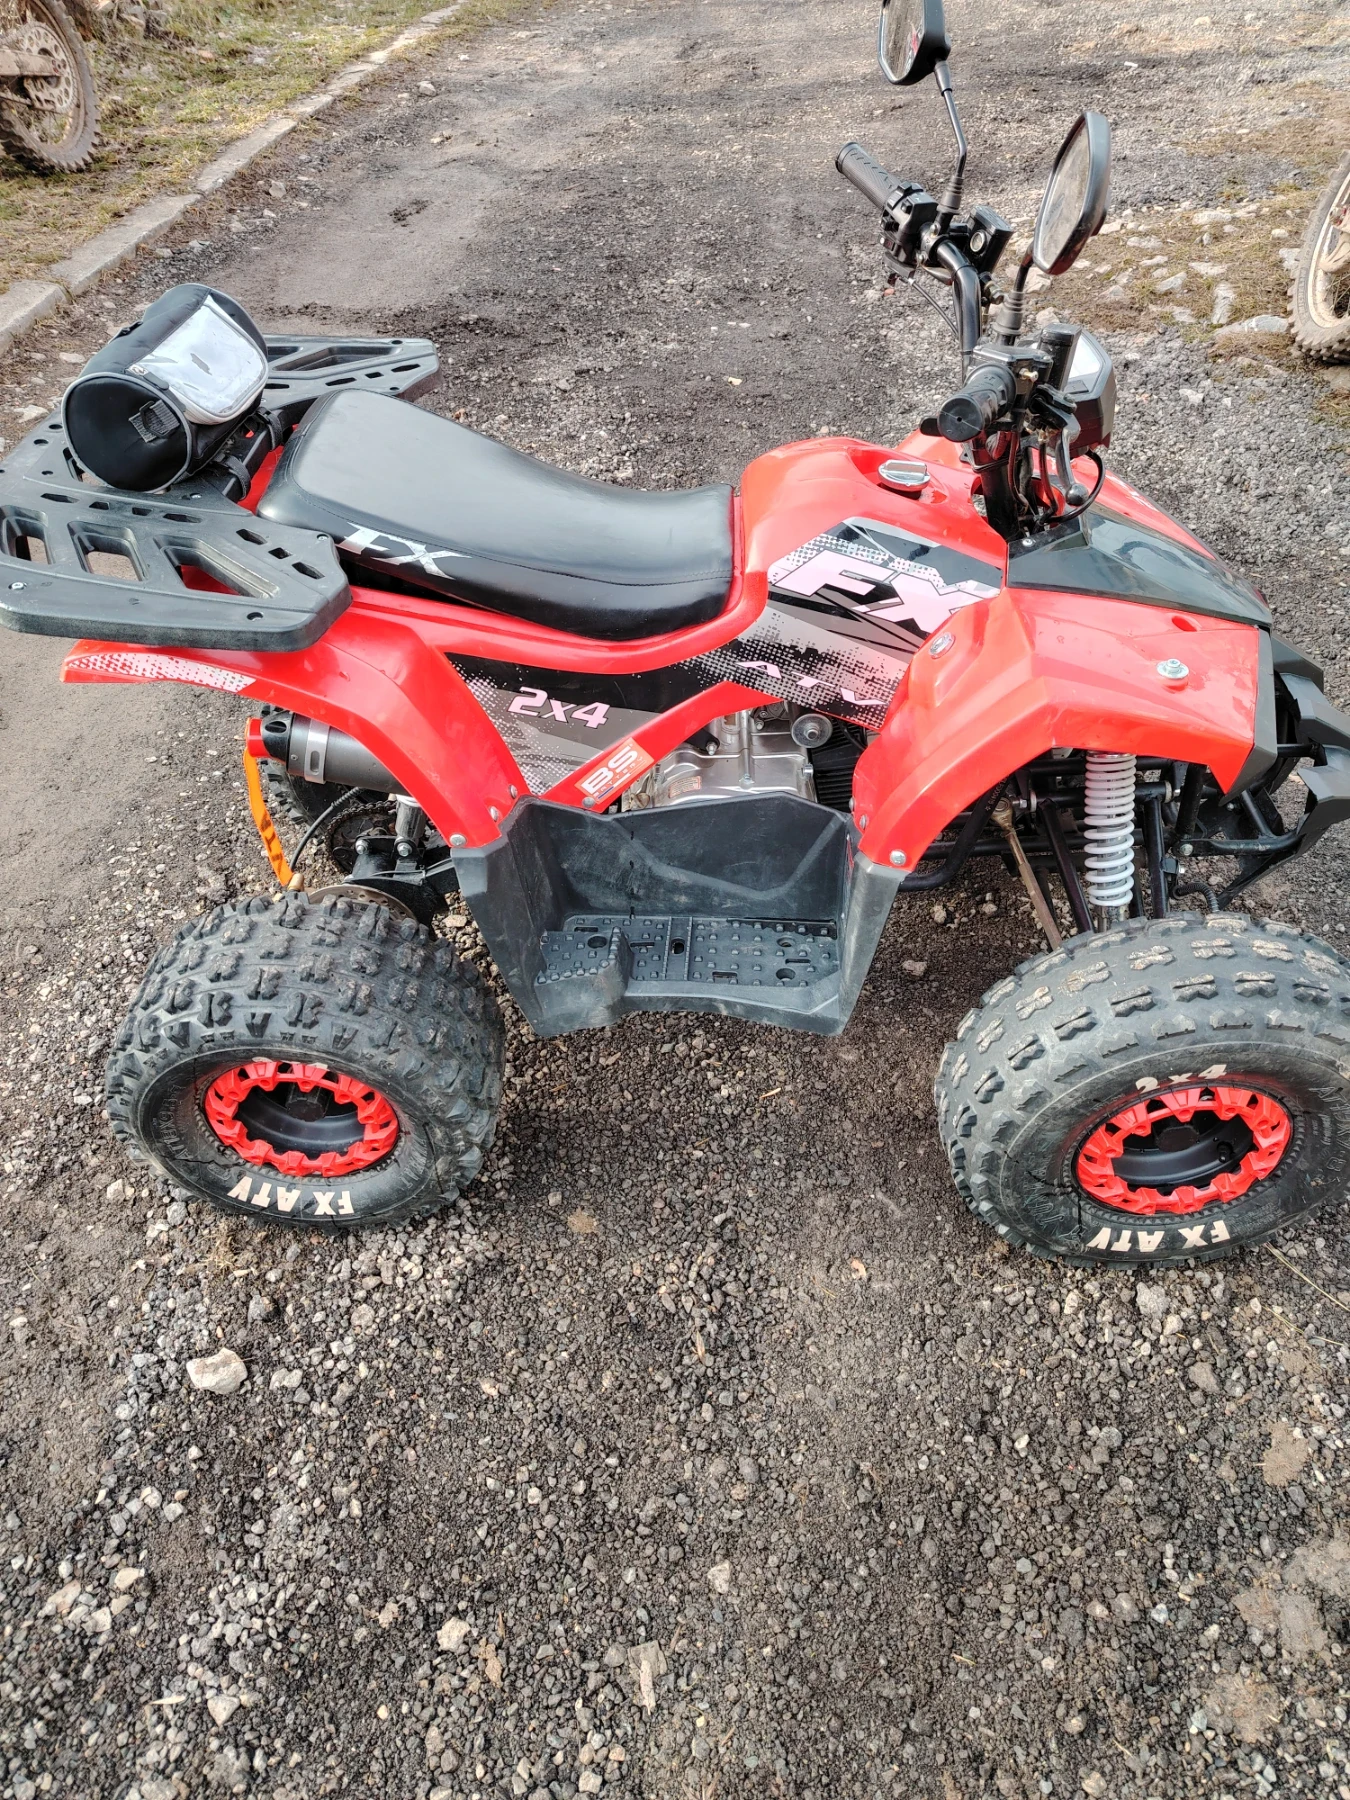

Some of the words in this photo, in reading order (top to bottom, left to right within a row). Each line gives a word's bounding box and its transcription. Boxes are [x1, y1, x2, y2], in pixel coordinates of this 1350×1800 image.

[773, 550, 986, 634] FX
[735, 661, 888, 706] ATV
[507, 686, 611, 729] 2x4
[580, 744, 638, 794] BS
[227, 1176, 302, 1212] ATV
[313, 1190, 355, 1216] FX
[1086, 1227, 1165, 1252] ATV
[1178, 1220, 1230, 1248] FX
